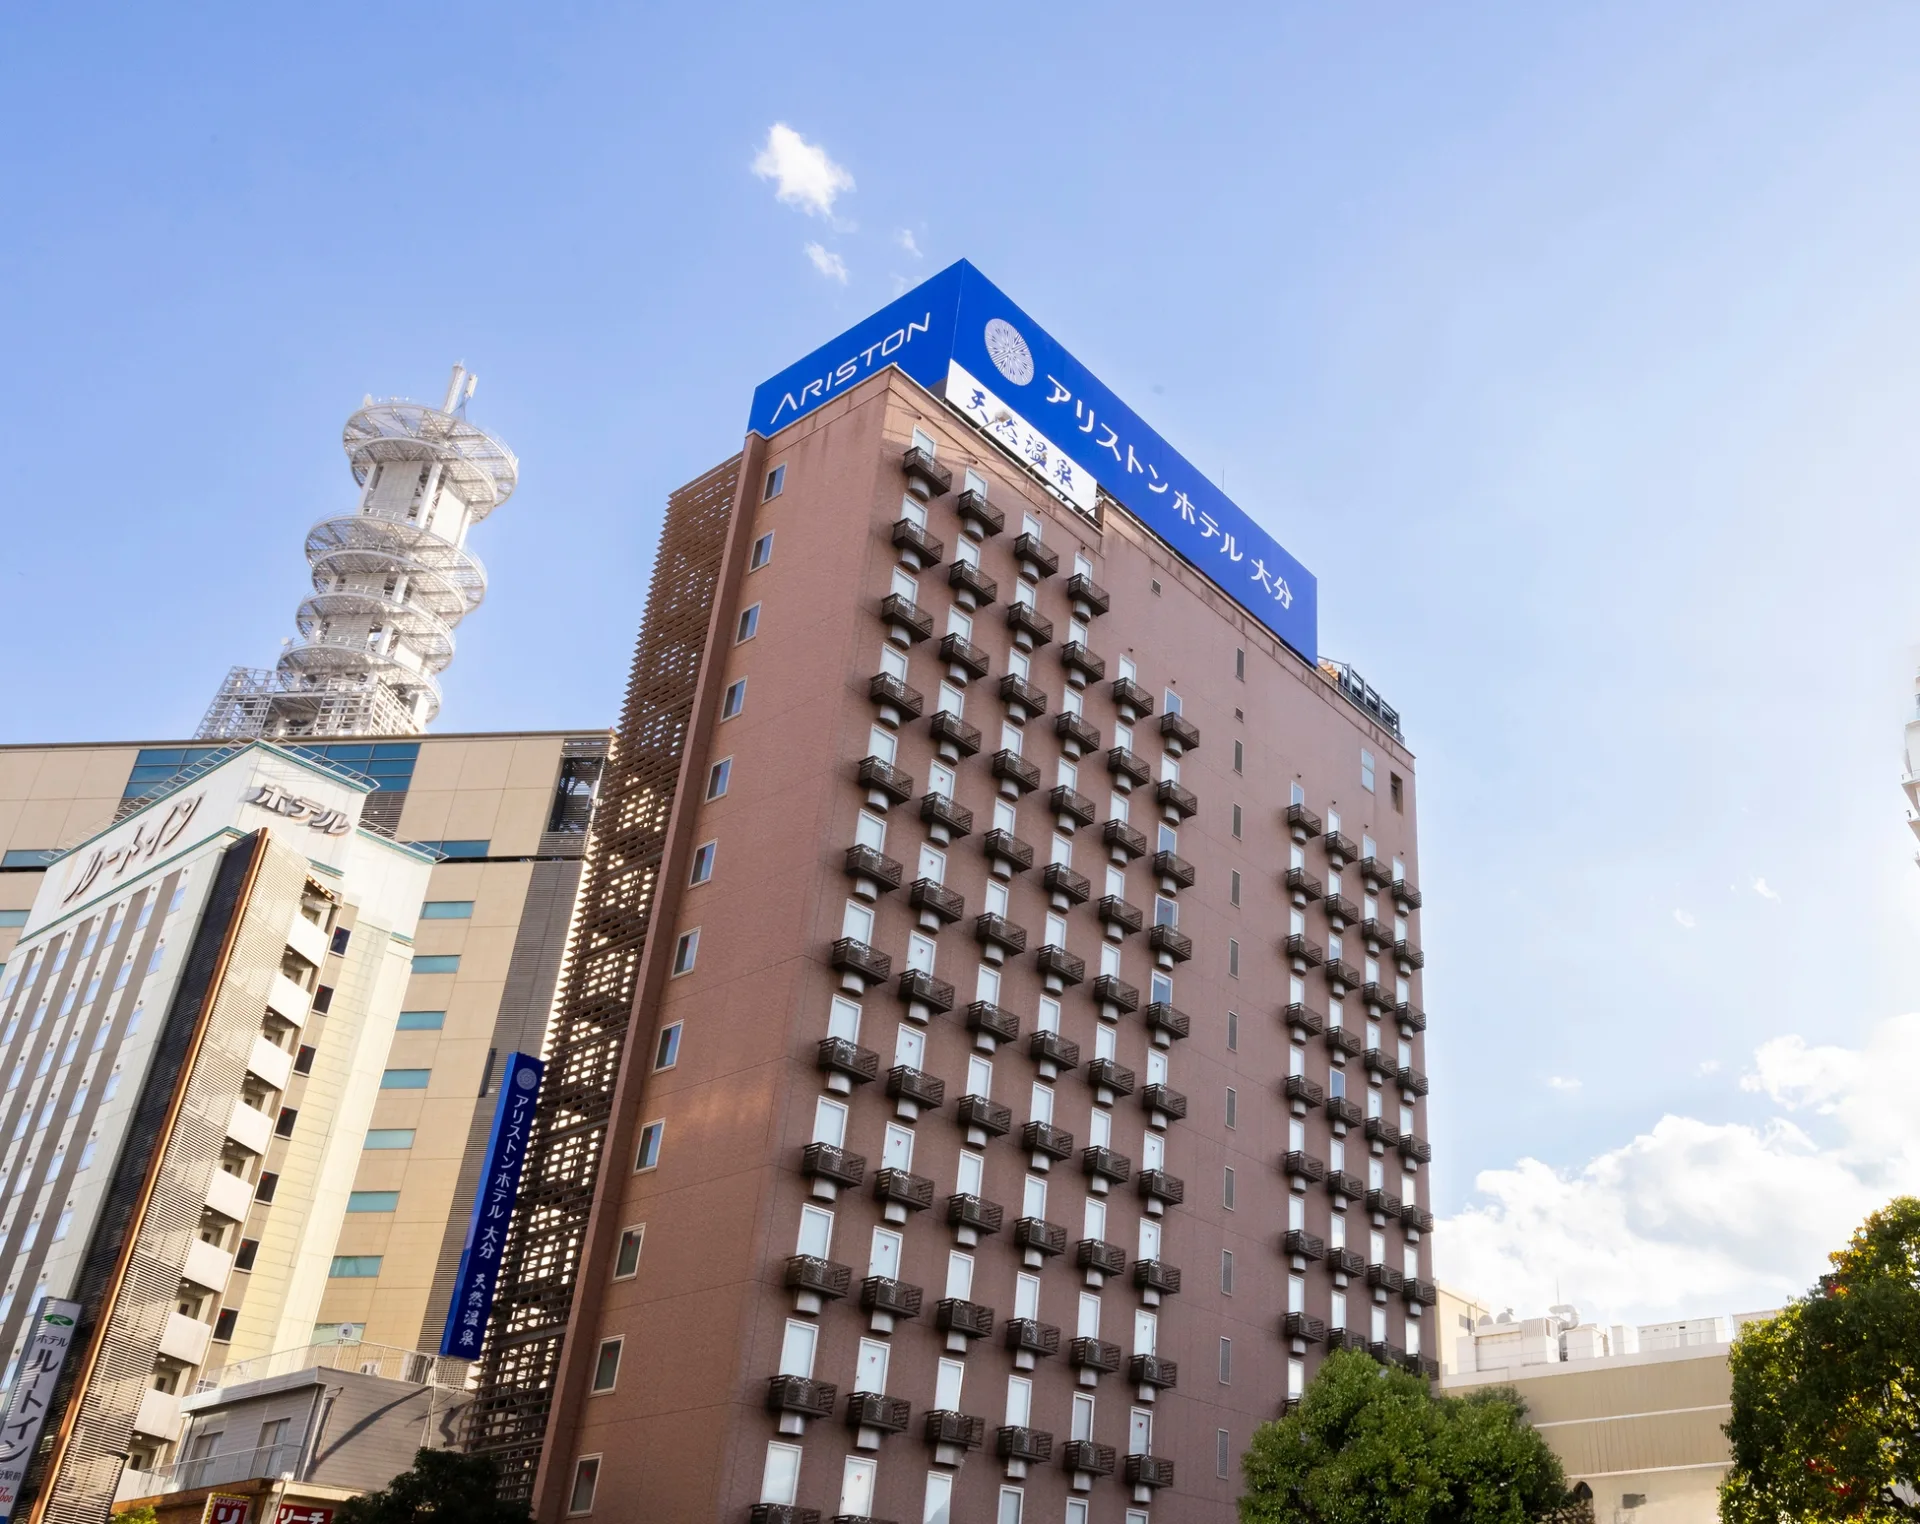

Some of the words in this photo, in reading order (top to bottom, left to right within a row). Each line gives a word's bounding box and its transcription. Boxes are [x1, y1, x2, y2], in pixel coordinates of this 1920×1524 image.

[771, 312, 930, 424] ARISTON
[966, 388, 1074, 491] 天然温泉
[62, 791, 205, 904] ルートイン
[255, 785, 351, 836] ホテル
[36, 1335, 68, 1347] ホテル
[458, 1273, 486, 1346] 天然温泉
[0, 1349, 59, 1462] ルートイン
[279, 1508, 325, 1524] リーチ
